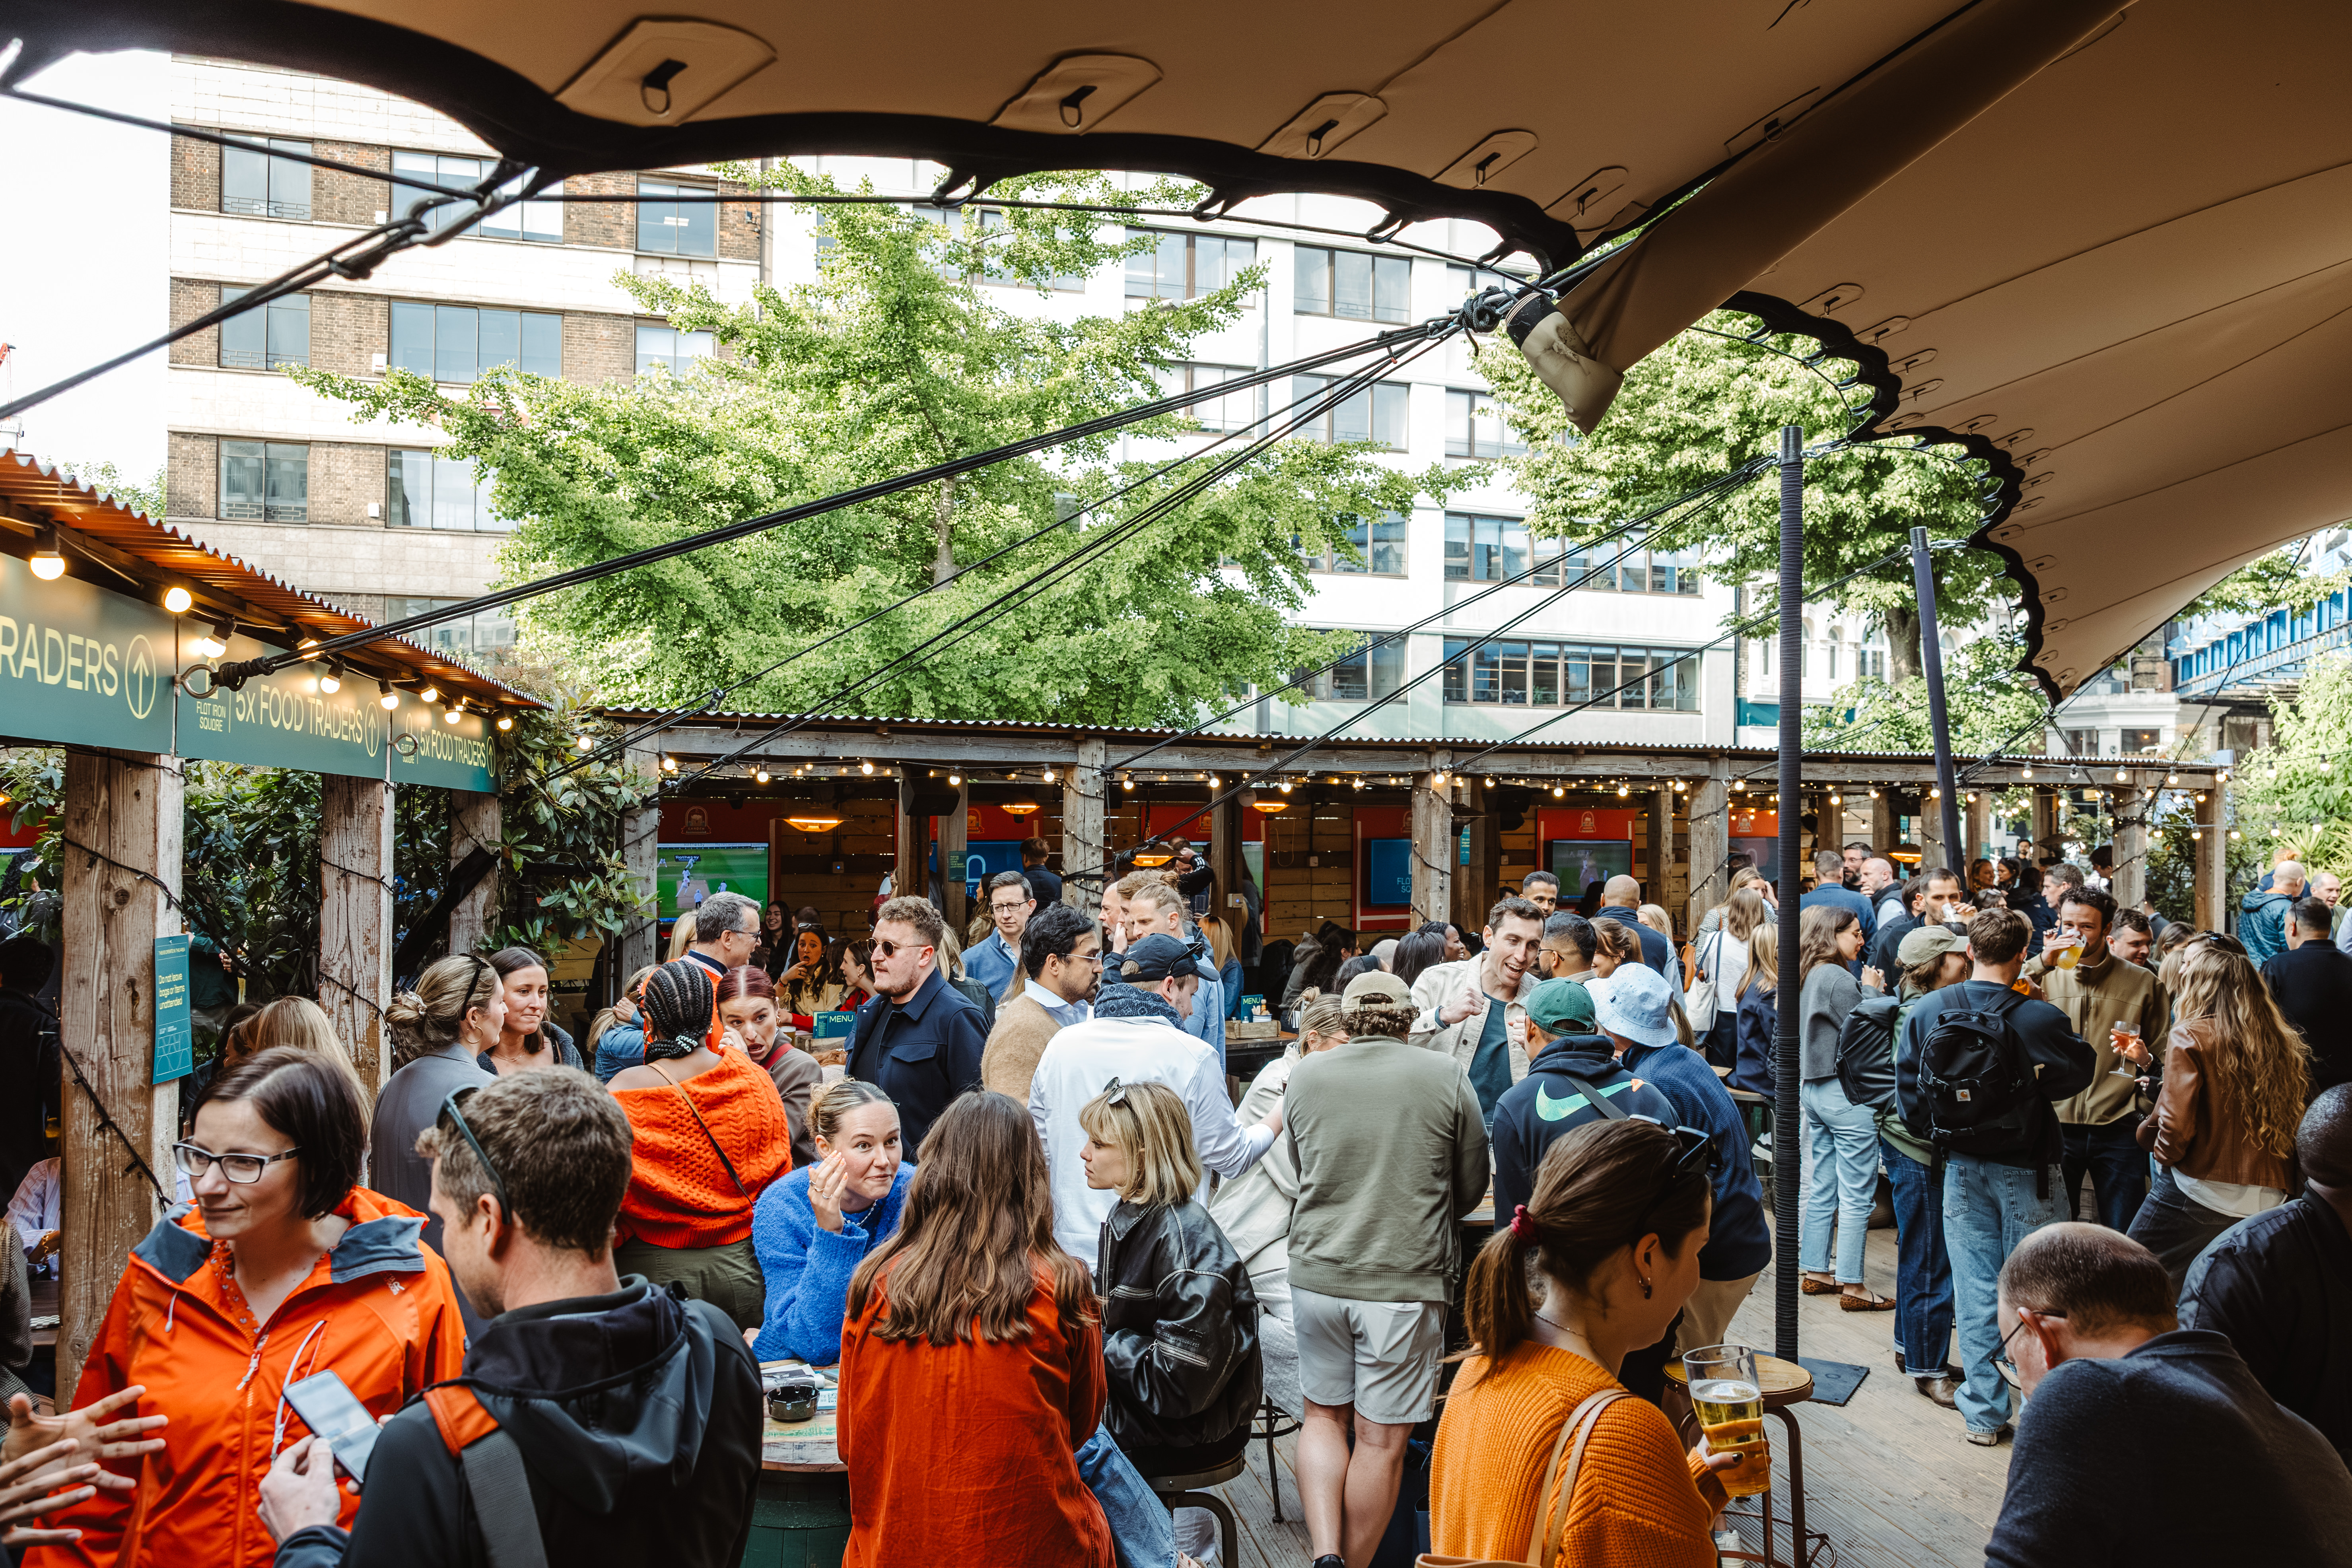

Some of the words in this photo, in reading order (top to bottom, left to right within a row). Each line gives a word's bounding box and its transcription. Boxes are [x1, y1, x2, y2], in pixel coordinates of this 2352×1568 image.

[212, 704, 225, 718] IRON
[260, 684, 304, 732] FOOD
[307, 697, 363, 744] TRADERS
[200, 716, 223, 732] SQUARE
[420, 727, 430, 757] 5x
[432, 729, 453, 761] FOOD
[454, 736, 486, 768] TRADERS
[159, 975, 165, 984] Do
[172, 973, 183, 981] leave
[159, 988, 170, 998] bags
[174, 985, 185, 993] items
[159, 995, 183, 1010] unattended
